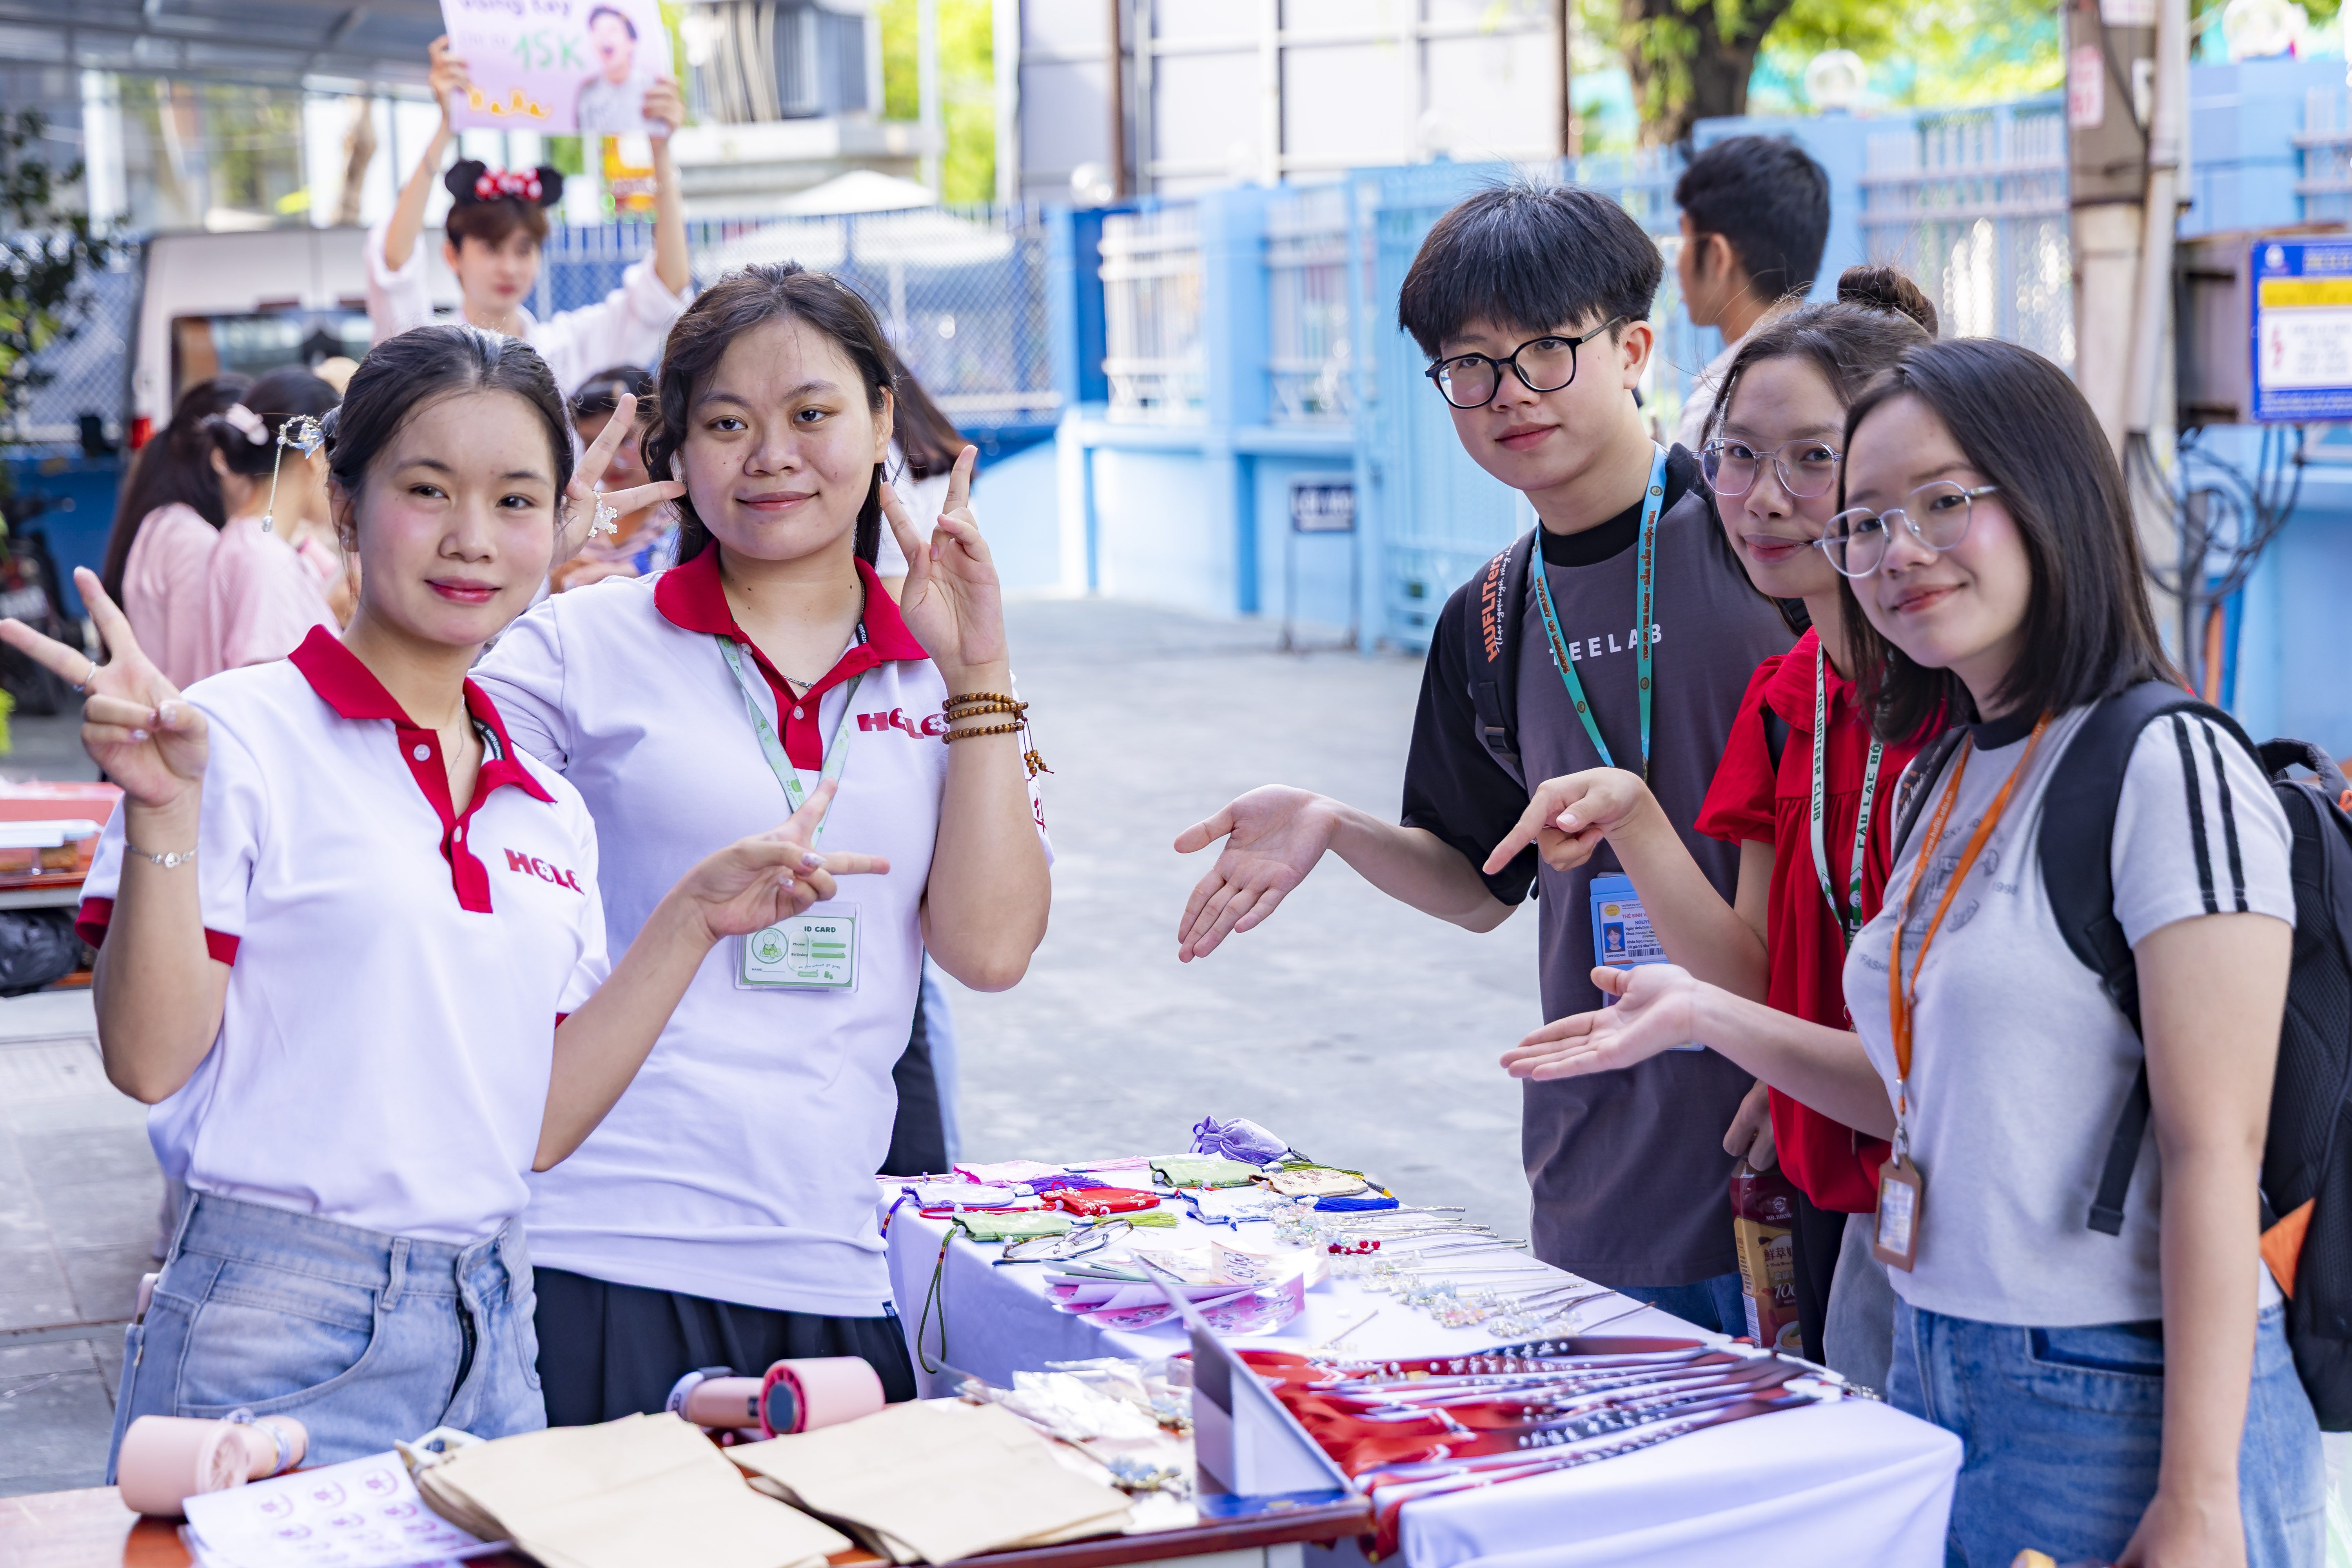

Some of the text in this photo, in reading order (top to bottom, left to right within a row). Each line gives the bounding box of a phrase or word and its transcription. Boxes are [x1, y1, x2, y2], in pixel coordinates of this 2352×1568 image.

[512, 29, 584, 68] 15K
[1482, 553, 1504, 663] HUFLITers
[1536, 575, 1570, 675] MYSTERY OF LEGENDS
[1642, 631, 1649, 642] OF
[1814, 688, 1823, 777] VOLUNTEER
[1813, 780, 1821, 822] CLUB
[1862, 772, 1875, 806] LẠC
[1857, 814, 1868, 849] CÂU
